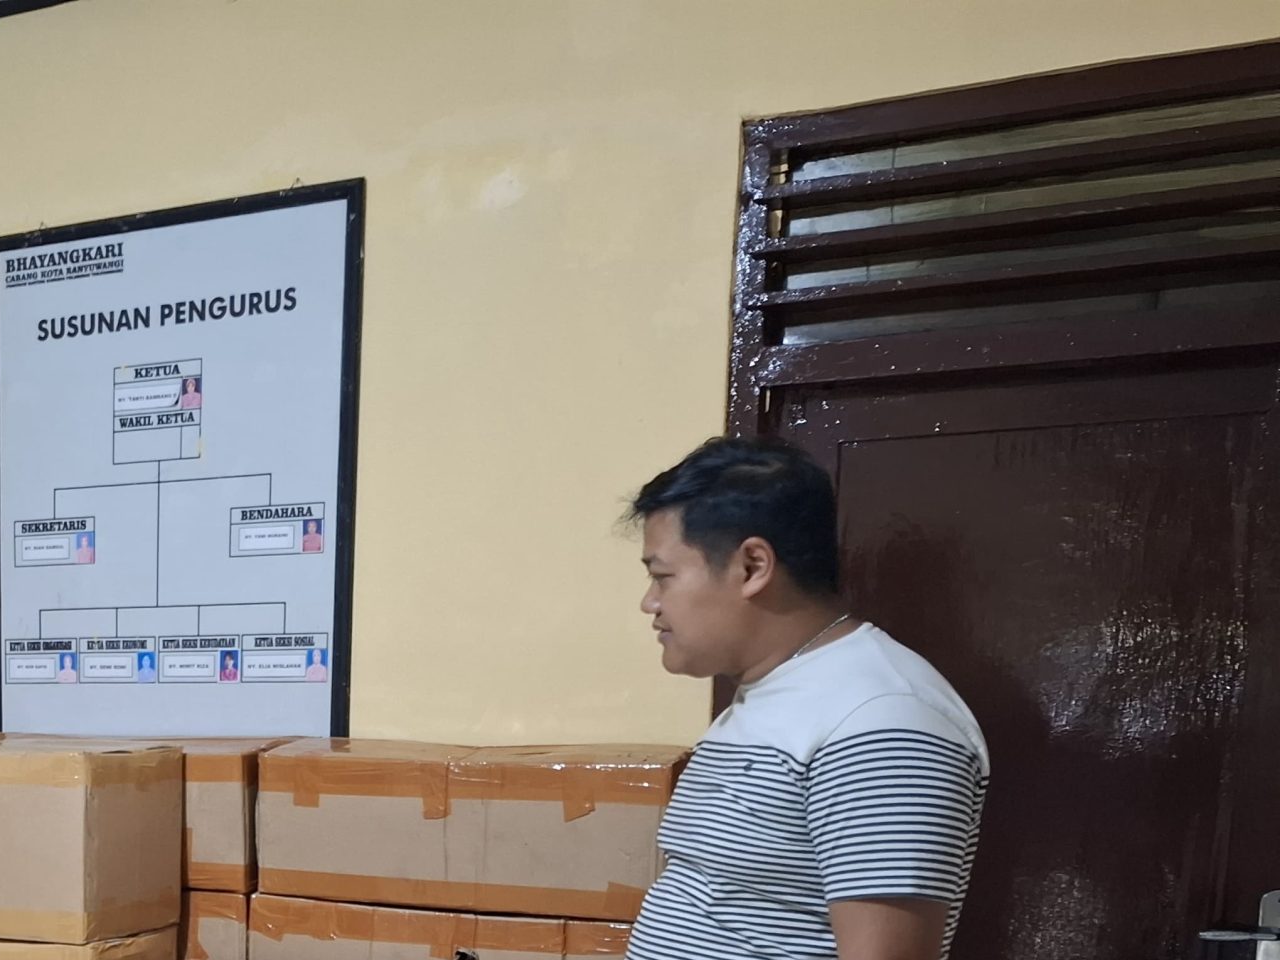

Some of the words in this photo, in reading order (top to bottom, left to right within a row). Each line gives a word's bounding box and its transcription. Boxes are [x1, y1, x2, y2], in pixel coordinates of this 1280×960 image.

[5, 242, 124, 273] BHAYANGKARI
[40, 268, 64, 279] KOTA
[37, 305, 151, 341] SUSUNAN
[159, 287, 297, 327] PENGURUS
[134, 364, 181, 379] KETUA
[119, 416, 154, 429] WAKIL
[157, 411, 195, 426] KETUA
[240, 506, 314, 521] BENDAHARA
[21, 520, 87, 534] SEKRETARIS
[254, 637, 273, 648] KETUA
[274, 636, 293, 647] SEKSI
[294, 636, 315, 647] SOSIAL
